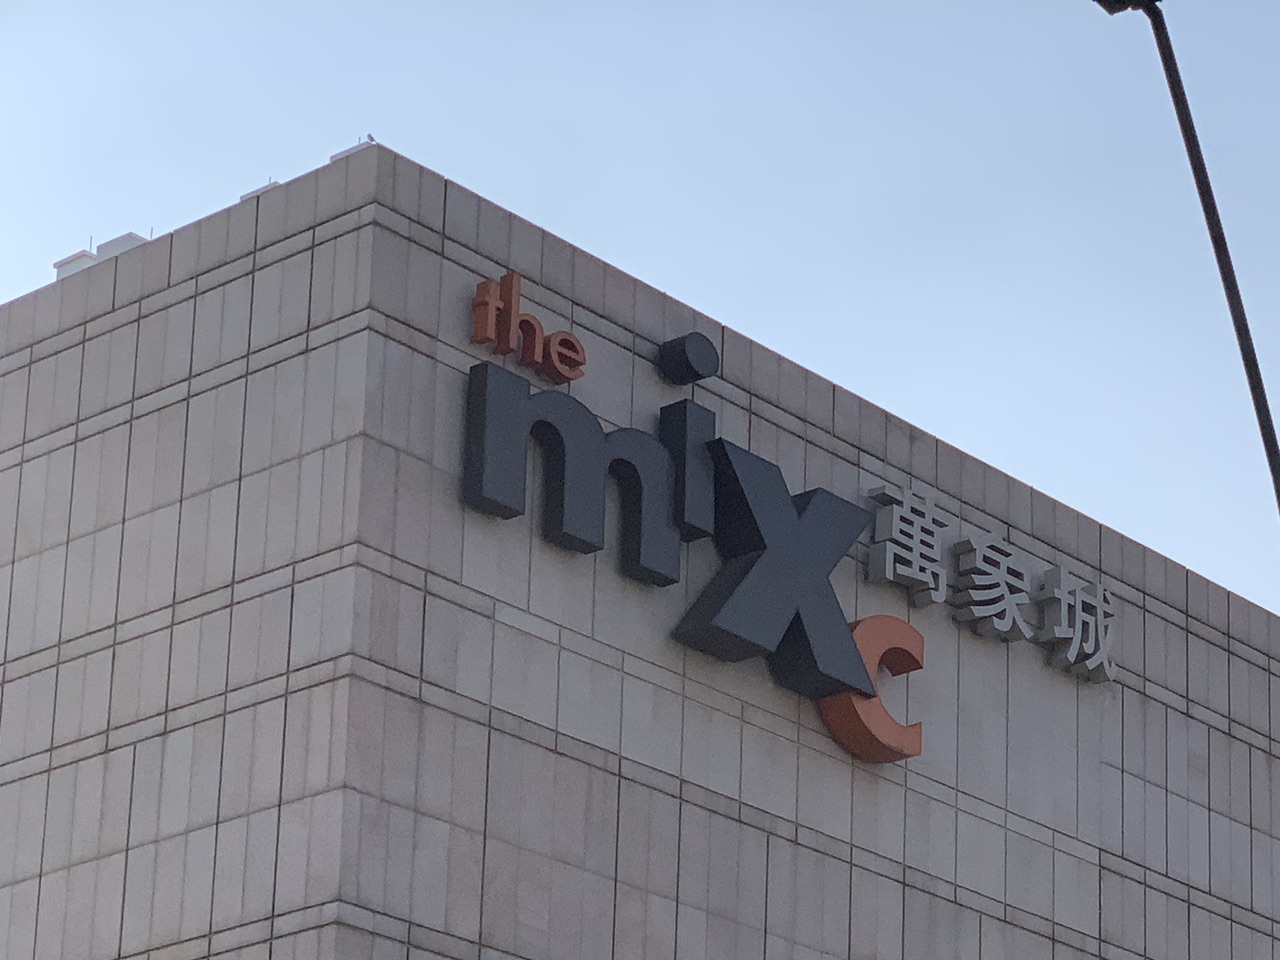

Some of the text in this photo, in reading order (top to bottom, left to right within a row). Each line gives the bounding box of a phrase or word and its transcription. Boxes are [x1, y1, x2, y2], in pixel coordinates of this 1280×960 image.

[472, 272, 586, 383] the
[866, 486, 1117, 682] 萬象城
